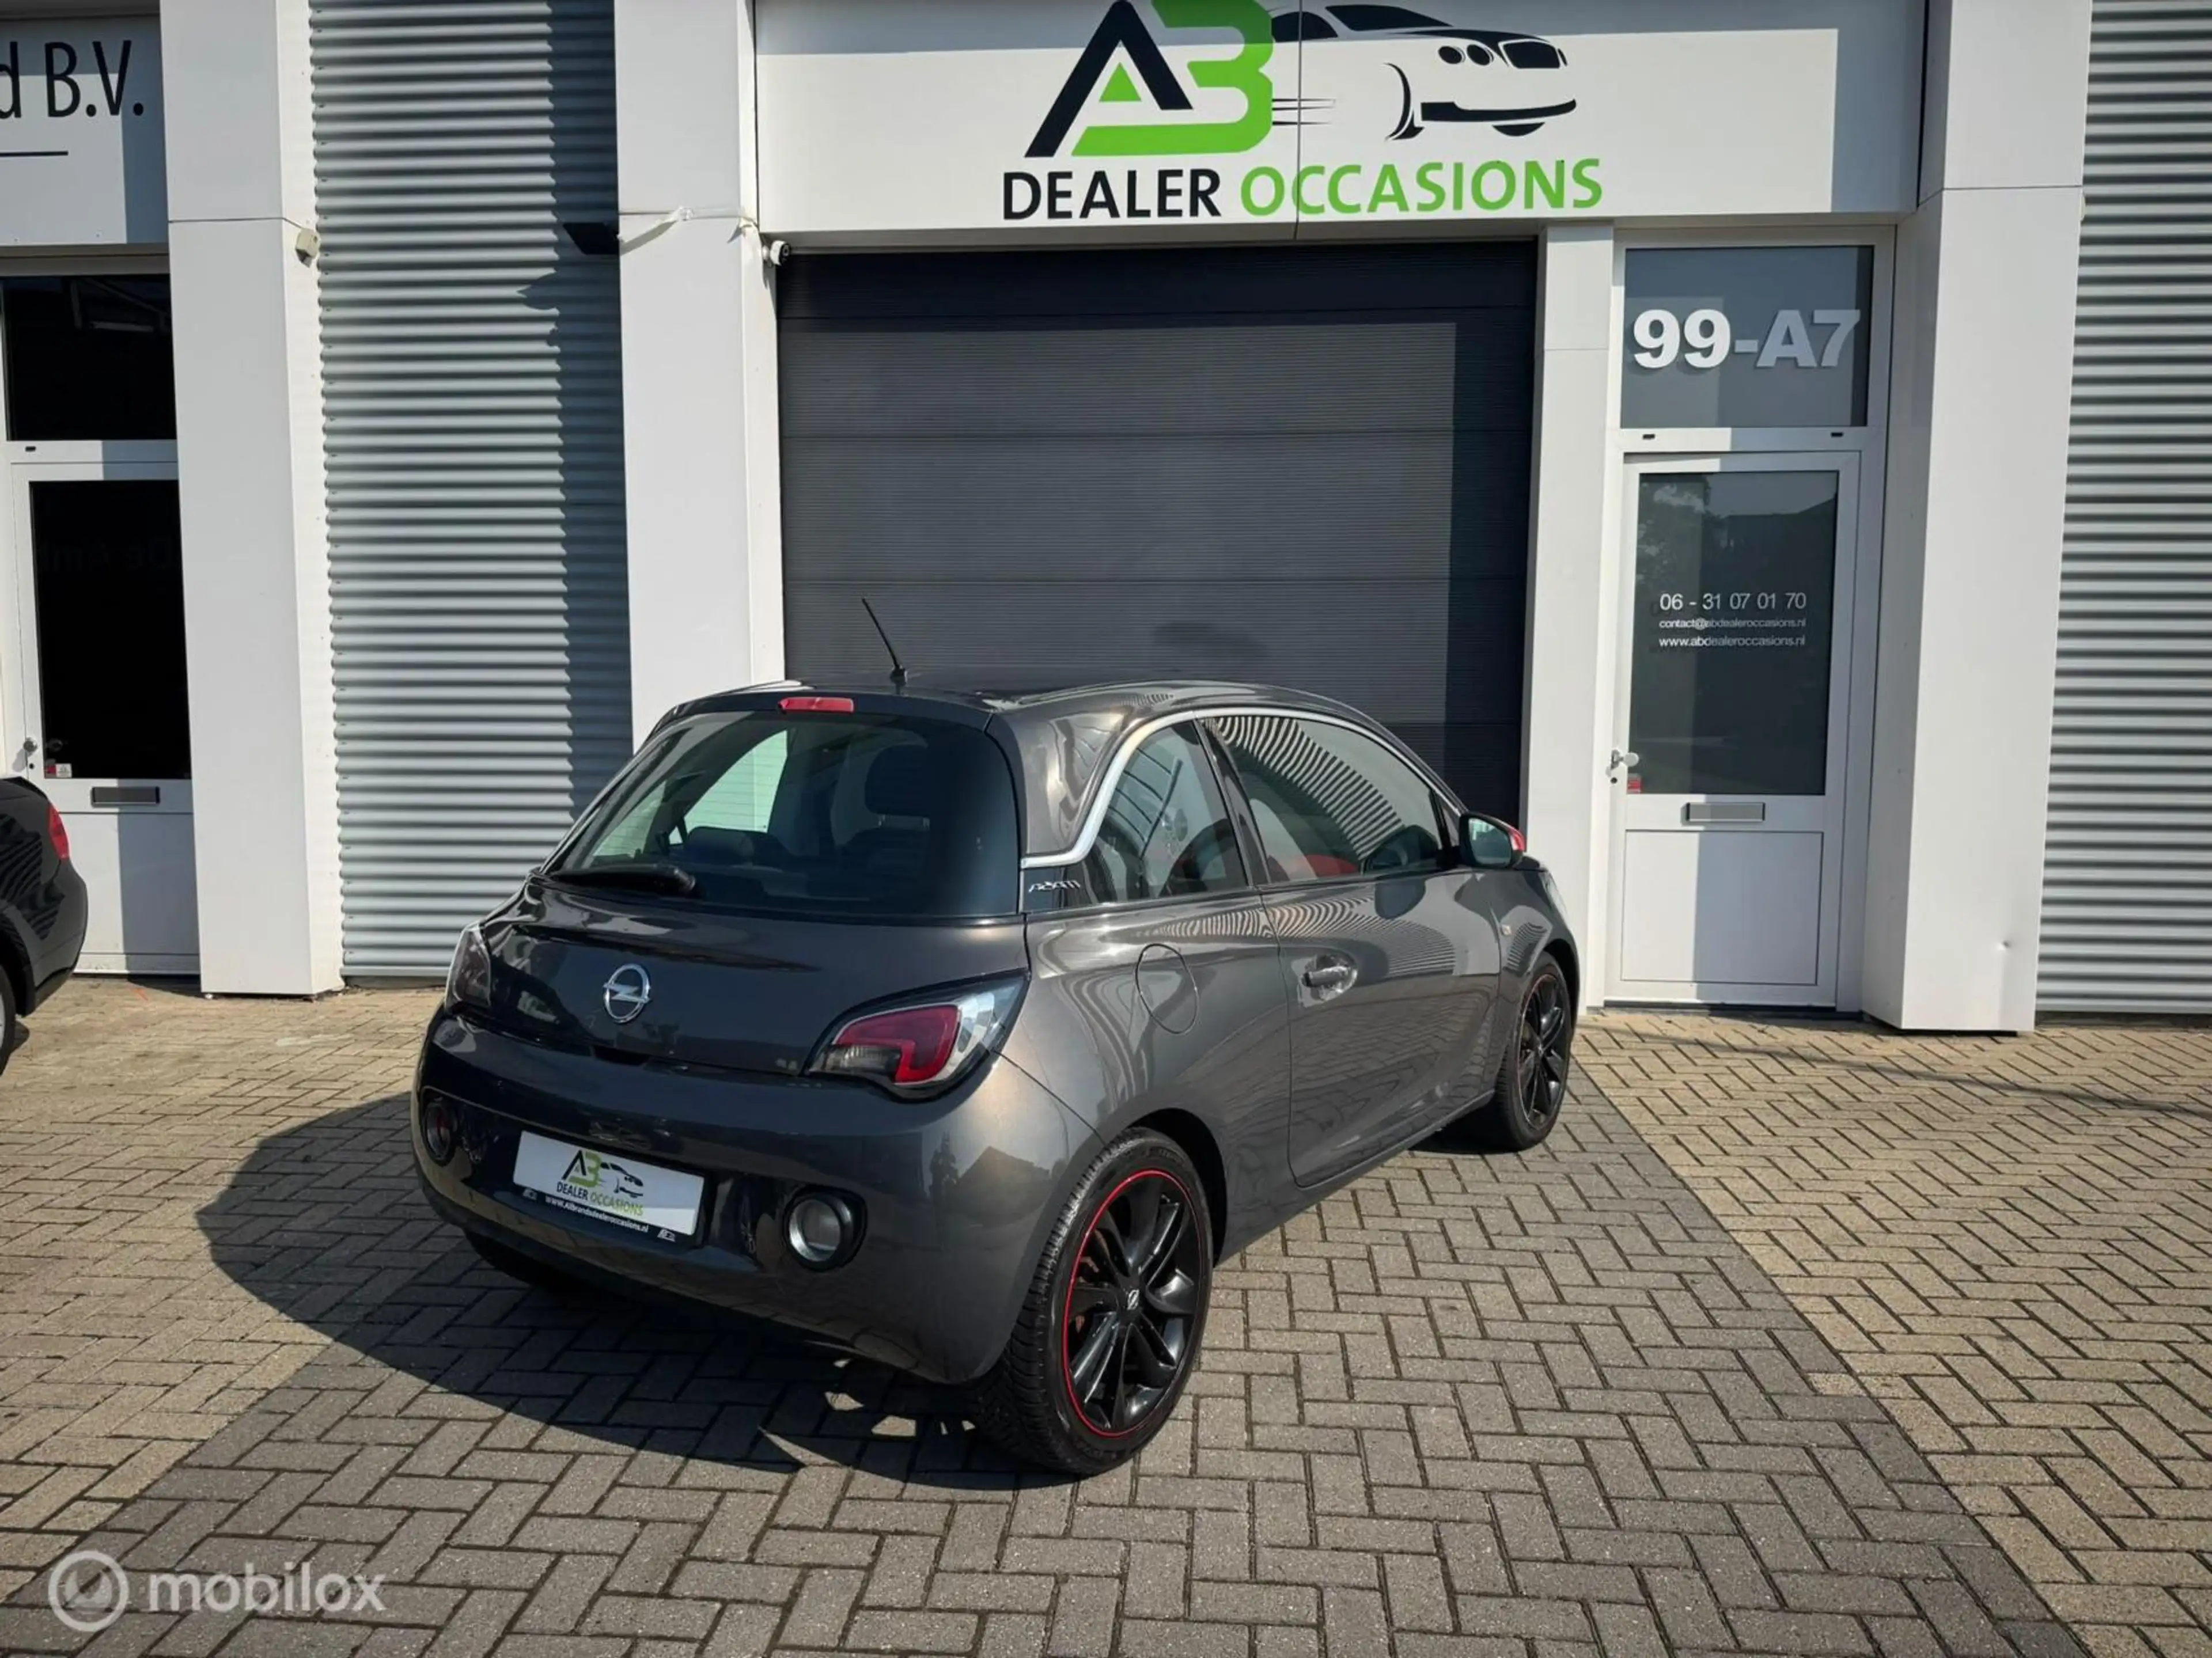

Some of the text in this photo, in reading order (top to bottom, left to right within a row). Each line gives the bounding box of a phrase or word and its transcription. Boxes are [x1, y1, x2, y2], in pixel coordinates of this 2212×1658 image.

[44, 40, 145, 118] B.V.
[1002, 158, 1604, 221] DEALER OCCASIONS
[1634, 309, 1861, 369] 99-A7
[1660, 593, 1684, 610] 06
[1702, 593, 1721, 610] 31
[1729, 592, 1751, 609] 07
[1757, 591, 1776, 609] 01
[1785, 591, 1806, 609] 70
[1658, 617, 1806, 631] contact@abdealeroccasions.nl
[1658, 635, 1806, 647] www.abdealeroccasions.nl
[556, 1181, 589, 1201] DEALER
[590, 1192, 643, 1216] OCCASIONS
